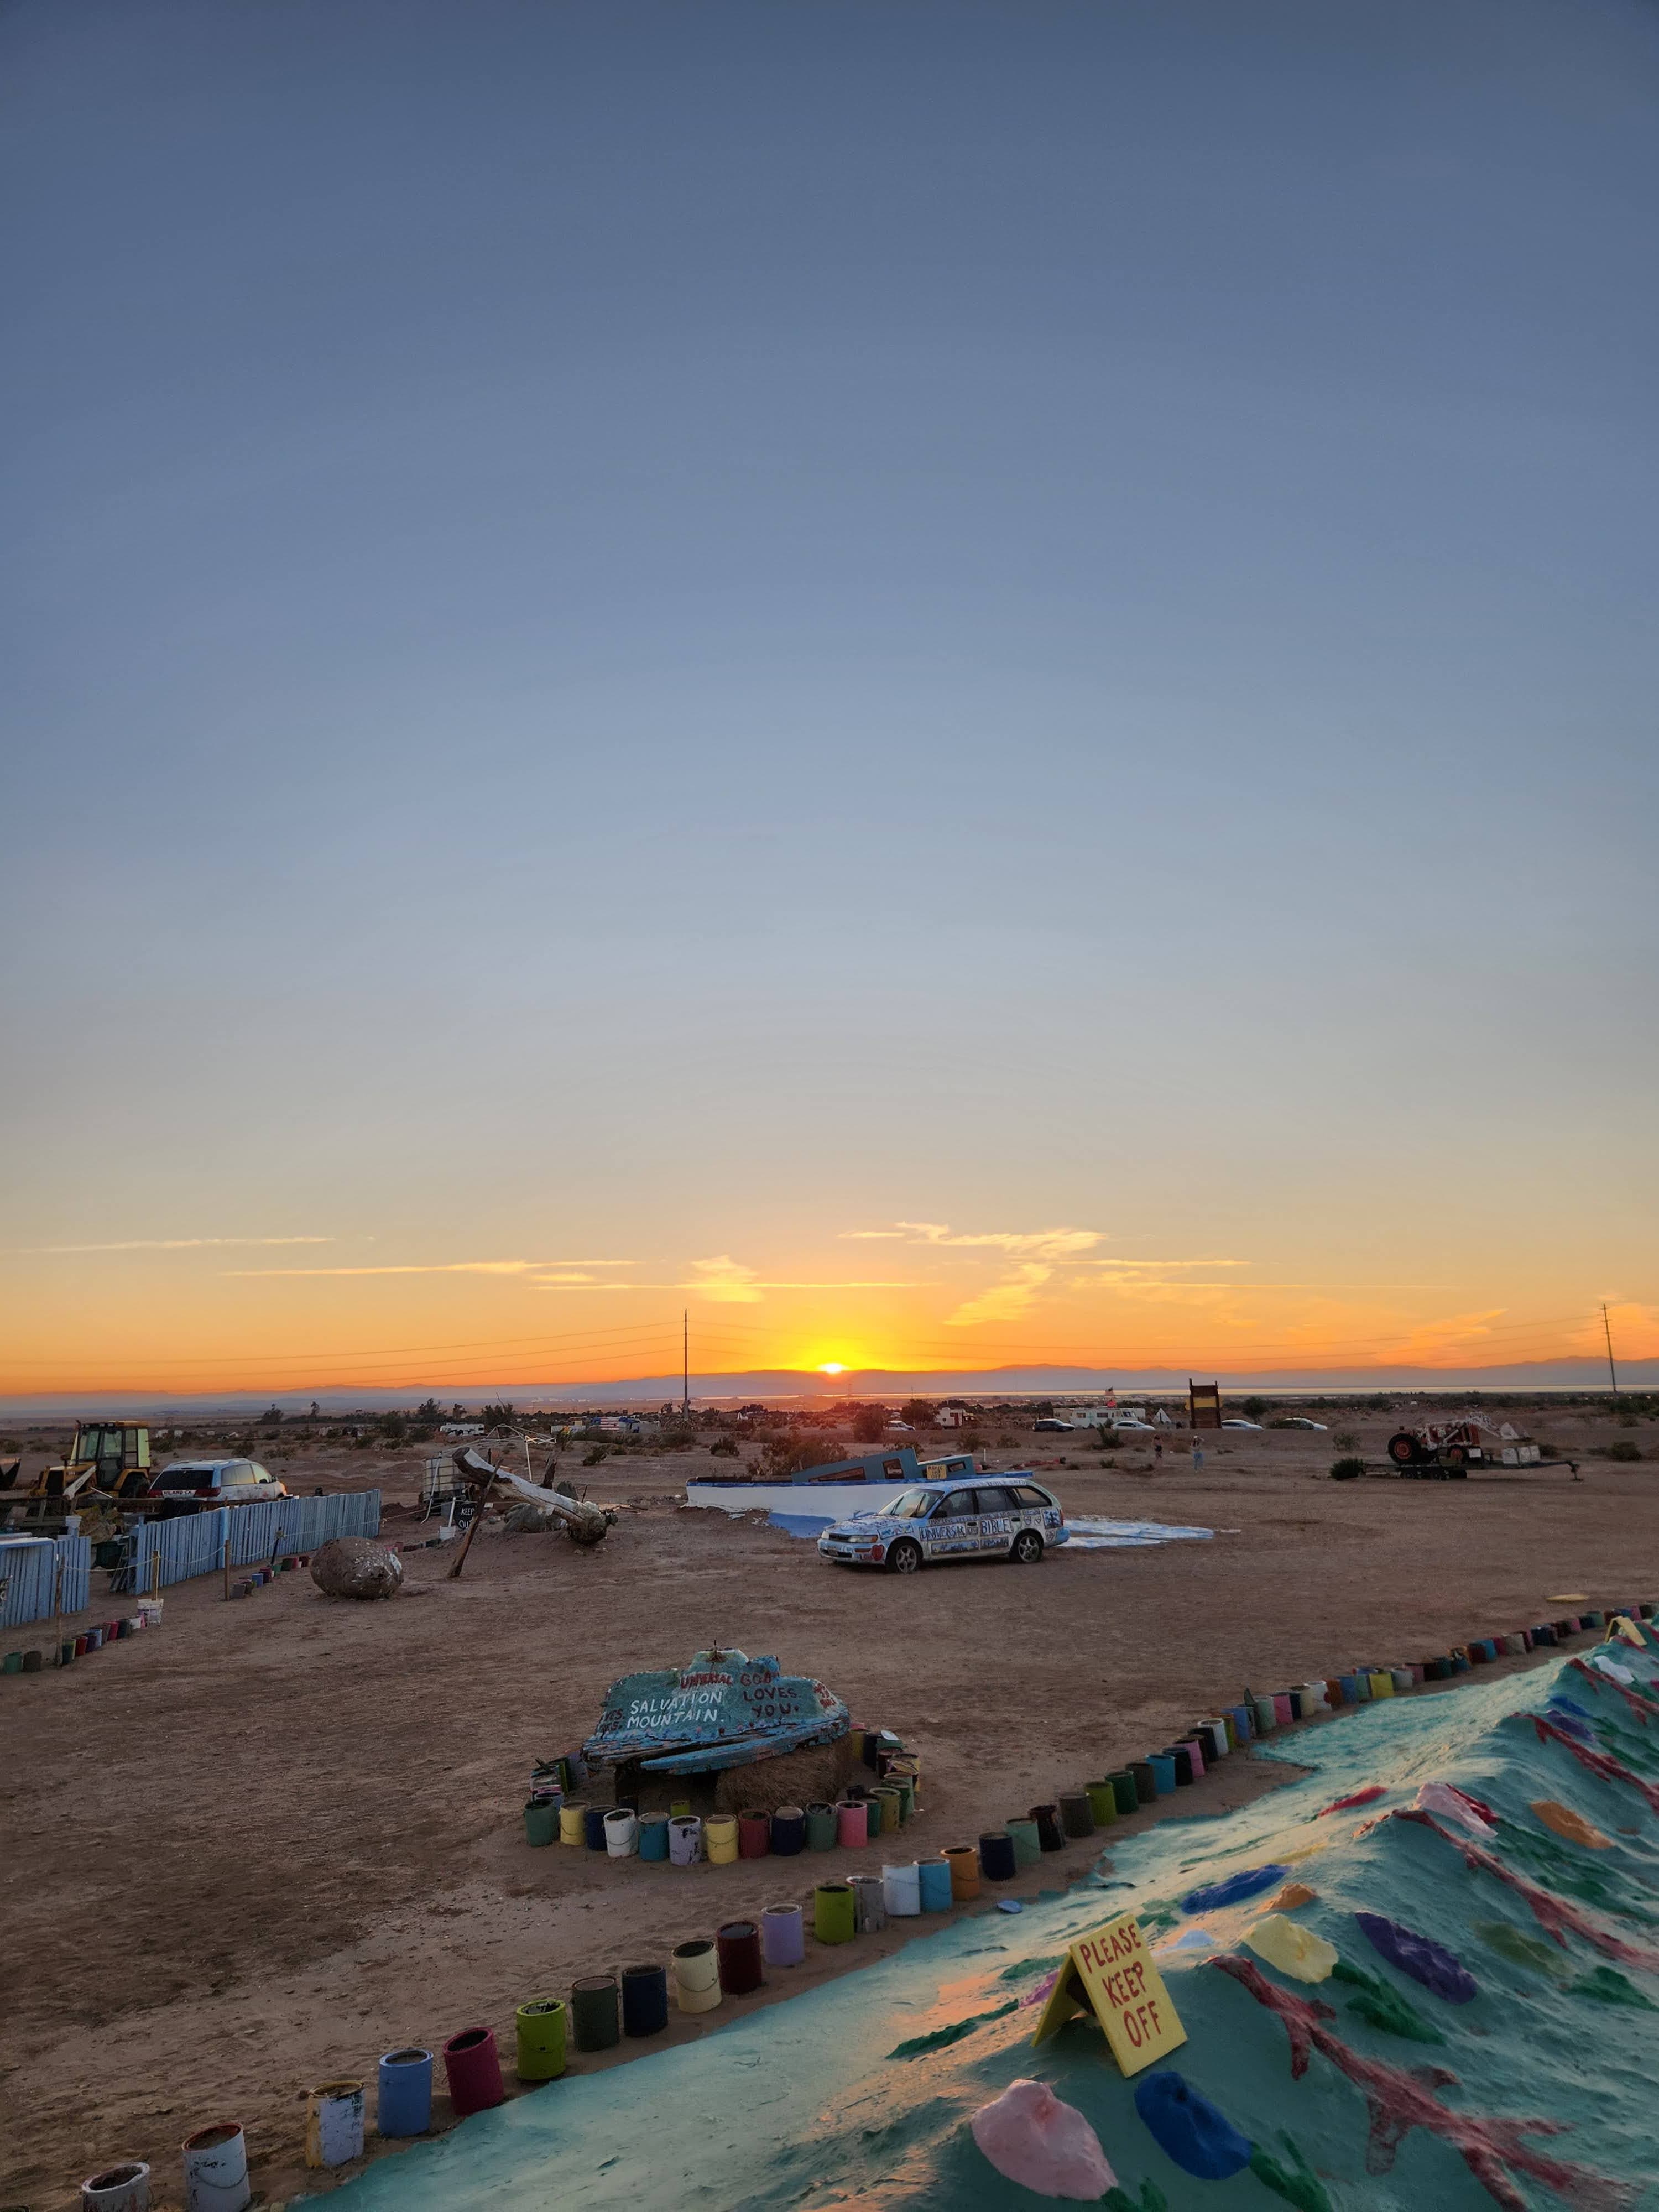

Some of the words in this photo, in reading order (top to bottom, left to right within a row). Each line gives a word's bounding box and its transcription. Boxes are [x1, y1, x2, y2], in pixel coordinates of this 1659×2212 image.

[459, 1520, 472, 1529] OU
[981, 1519, 1009, 1535] BIBLE
[630, 1691, 723, 1715] SALVATION
[627, 1708, 724, 1729] MOUNTAIN.
[1079, 1923, 1141, 1974] PLEASE
[1102, 1961, 1147, 2008] KEEP
[1123, 2000, 1161, 2047] OFF
